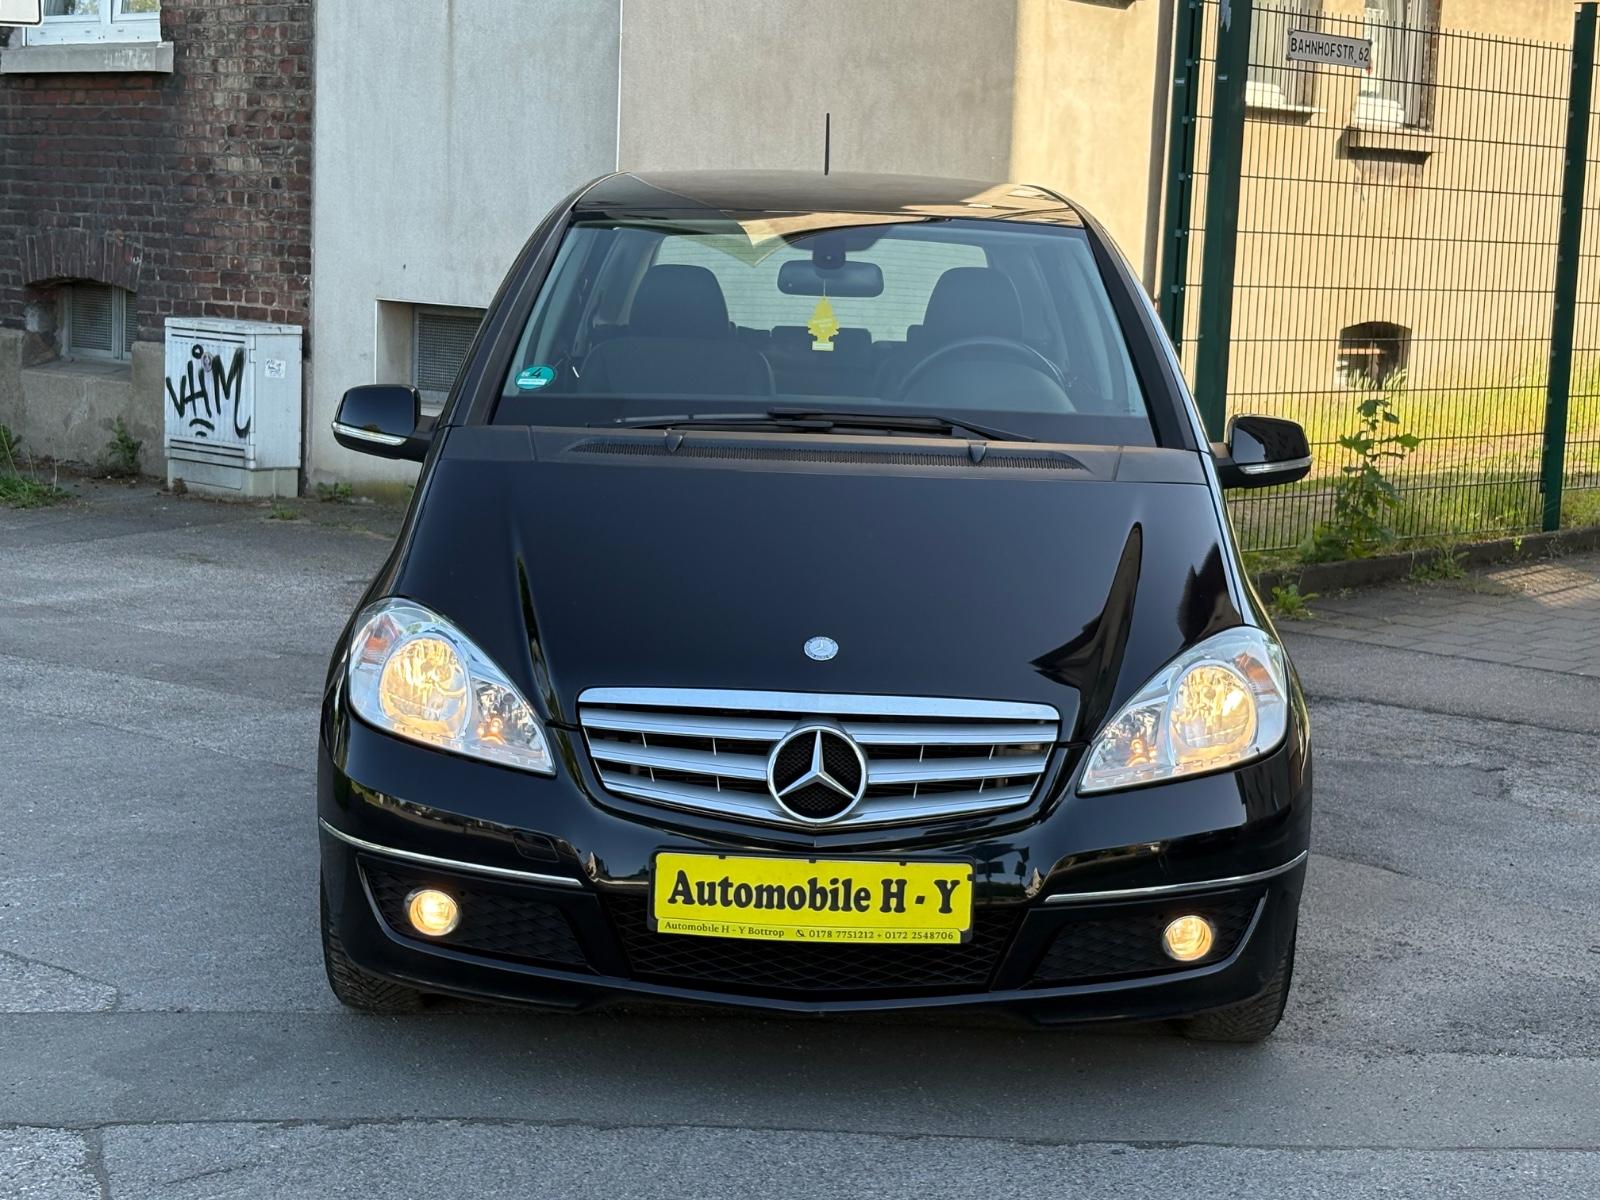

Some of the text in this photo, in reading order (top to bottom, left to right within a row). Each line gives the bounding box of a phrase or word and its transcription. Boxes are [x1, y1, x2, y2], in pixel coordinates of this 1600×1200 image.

[1358, 47, 1369, 62] 62
[530, 367, 542, 378] 4
[667, 869, 960, 914] Automobile H - Y
[664, 921, 720, 933] Automobile
[721, 926, 730, 934] H
[739, 926, 746, 934] Y
[748, 927, 785, 938] Bottrop
[808, 929, 833, 938] 0178
[836, 930, 874, 939] 7751212
[885, 931, 908, 939] 0172
[911, 931, 954, 940] 2548706
